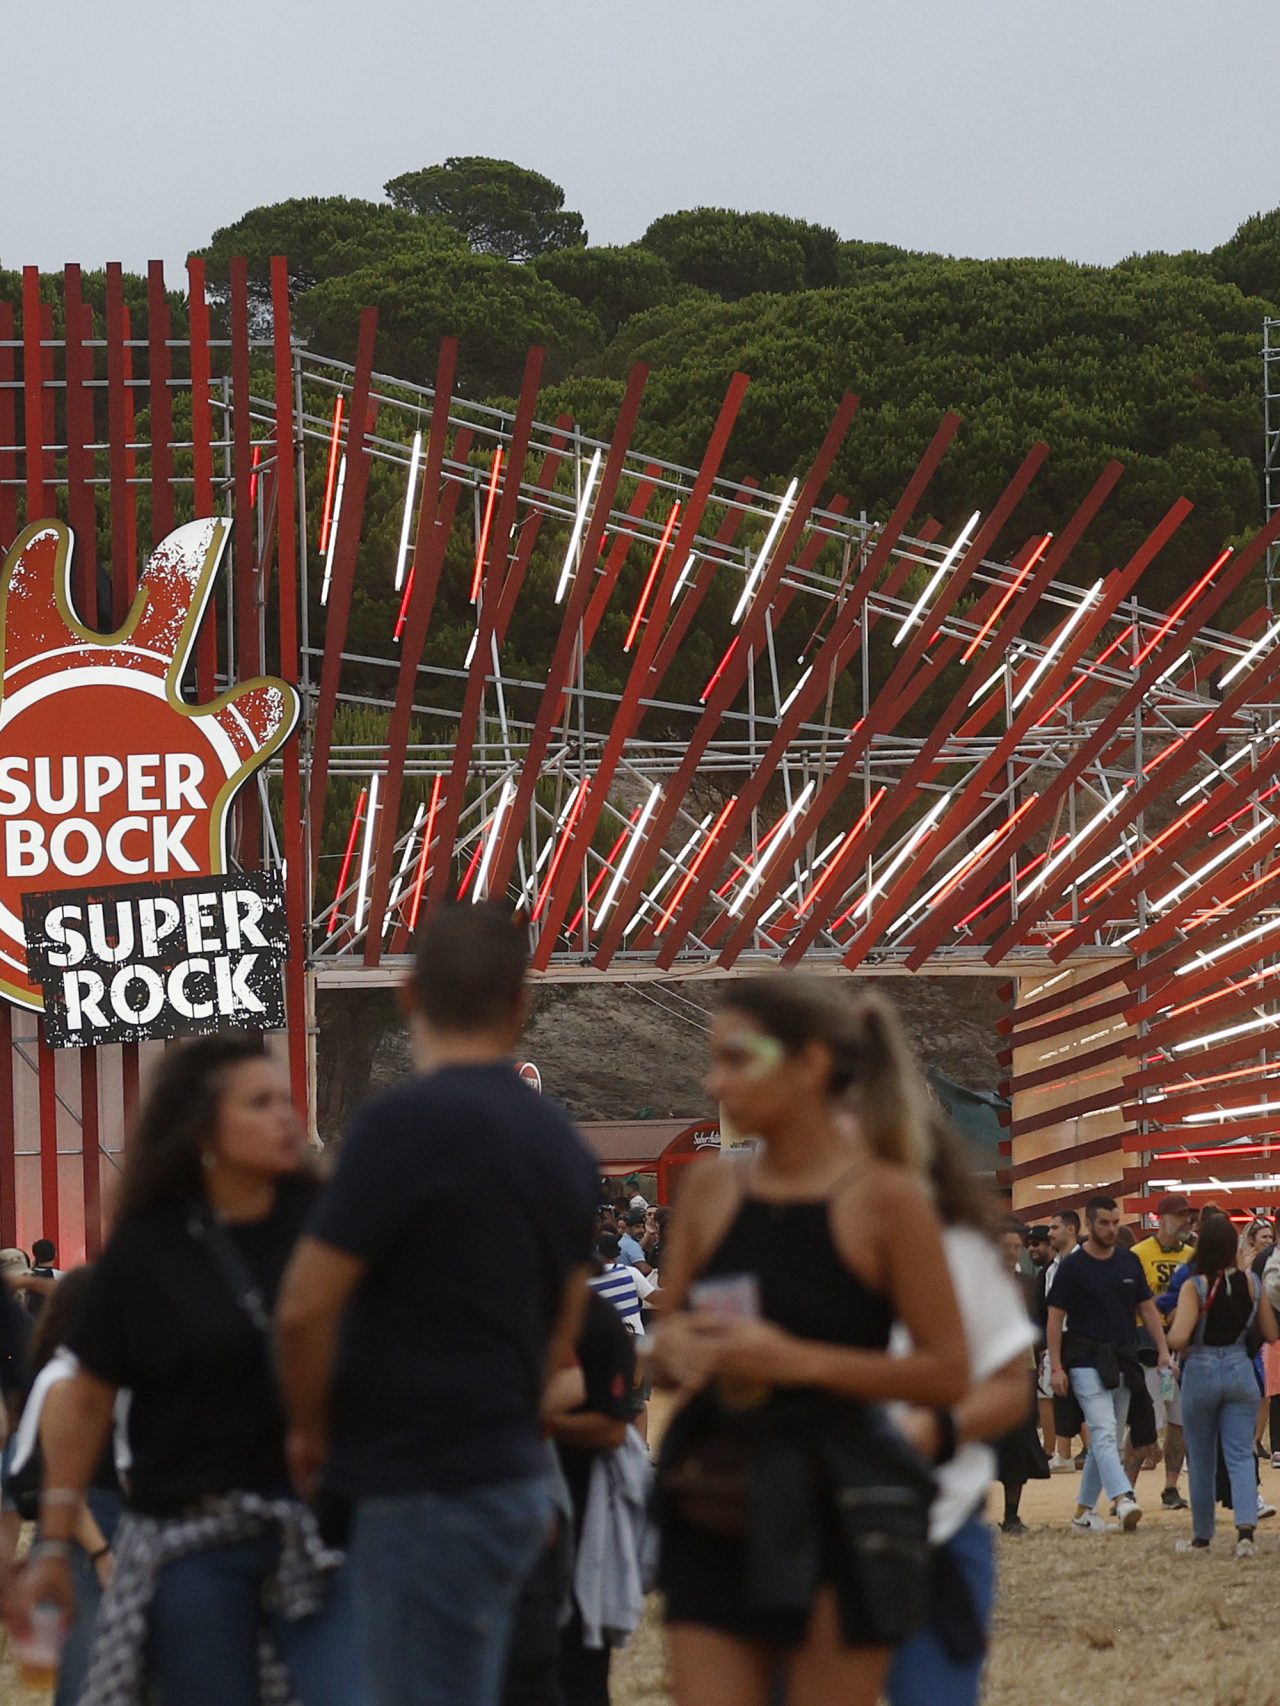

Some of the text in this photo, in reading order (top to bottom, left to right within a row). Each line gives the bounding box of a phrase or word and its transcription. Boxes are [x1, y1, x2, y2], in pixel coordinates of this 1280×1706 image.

[5, 815, 200, 877] BOCK
[44, 889, 270, 966] SUPER
[63, 954, 265, 1030] ROCK
